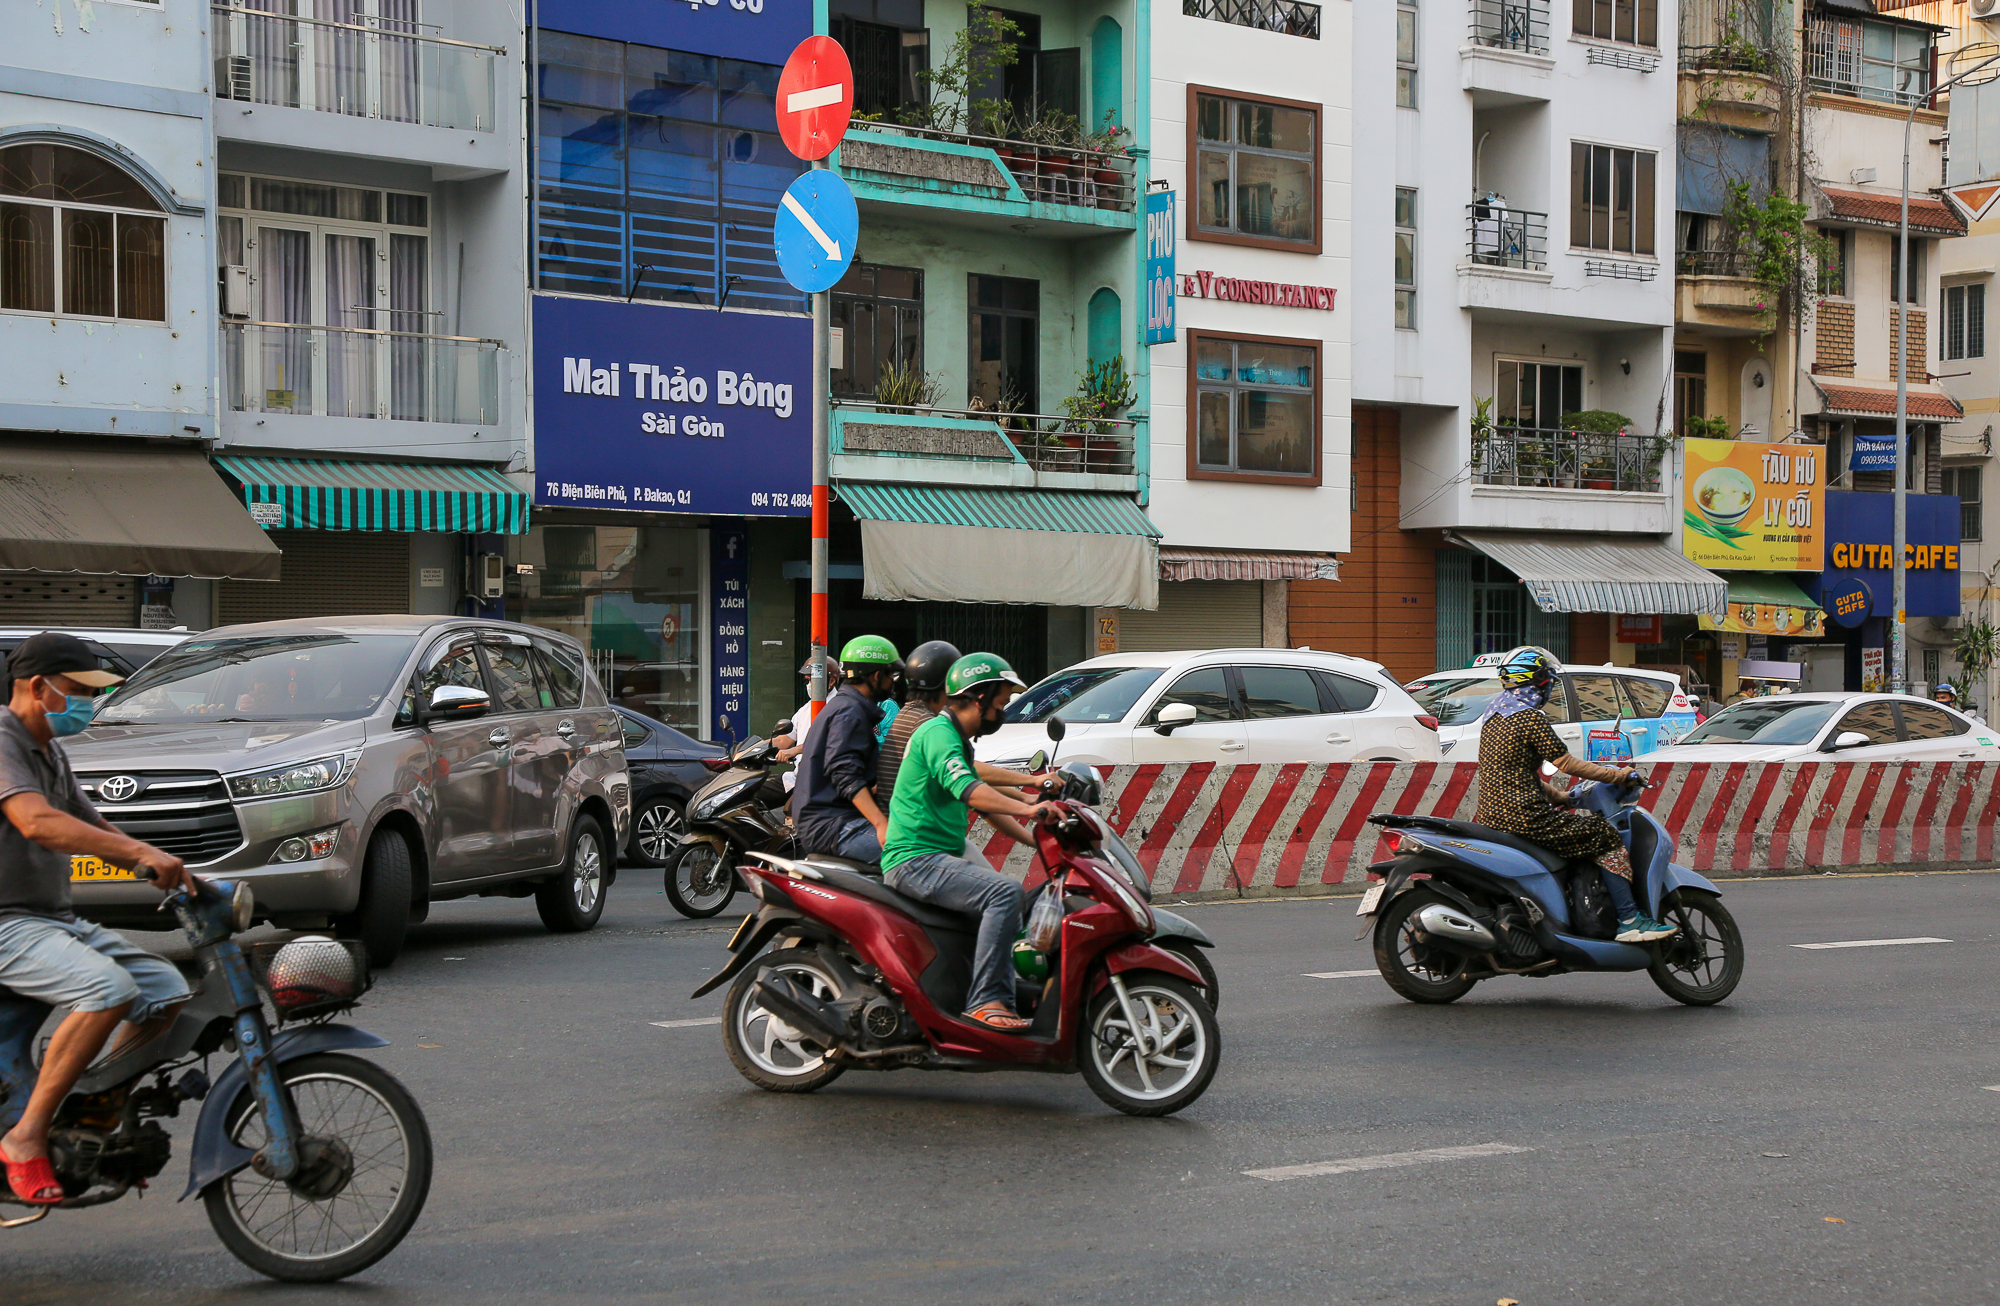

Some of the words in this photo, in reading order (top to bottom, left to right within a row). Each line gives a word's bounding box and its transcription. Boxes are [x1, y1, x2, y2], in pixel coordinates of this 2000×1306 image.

[1147, 194, 1173, 260] PHỞ
[1184, 276, 1196, 296] &
[1197, 270, 1214, 298] V
[1215, 277, 1337, 311] CONSULTANCY
[1148, 266, 1172, 340] LỘC
[563, 357, 620, 396] Mai
[628, 362, 708, 403] Thảo
[717, 370, 793, 418] Bông
[641, 411, 676, 434] Sài
[682, 415, 725, 438] Gòn
[1871, 441, 1885, 451] BÁN
[1761, 449, 1790, 484] TÀU
[1794, 449, 1816, 485] HỦ
[546, 482, 559, 496] 76
[561, 483, 583, 500] Điện
[584, 484, 606, 500] Biên
[607, 485, 627, 503] Phủ,
[634, 487, 643, 501] P.
[644, 487, 675, 506] Đakao,
[751, 492, 769, 507] 094
[771, 493, 789, 507] 762
[790, 493, 813, 508] 4884
[1763, 497, 1782, 527] LY
[1786, 489, 1812, 528] CỐI
[1832, 542, 1894, 569] GUTA
[1904, 543, 1958, 569] CAFE
[725, 579, 739, 591] TÚI
[720, 598, 745, 608] XÁCH
[1836, 591, 1864, 606] GUTA
[1837, 600, 1866, 616] CAFE
[719, 622, 745, 636] ĐỒNG
[1100, 618, 1116, 634] 72
[726, 640, 739, 654] HỒ
[860, 652, 889, 661] ROBINS
[720, 666, 745, 677] HÀNG
[962, 663, 991, 678] Grab
[722, 683, 743, 697] HIỆU
[726, 700, 739, 712] CŨ
[788, 880, 838, 900] VISION
[1069, 921, 1095, 930] HONDA
